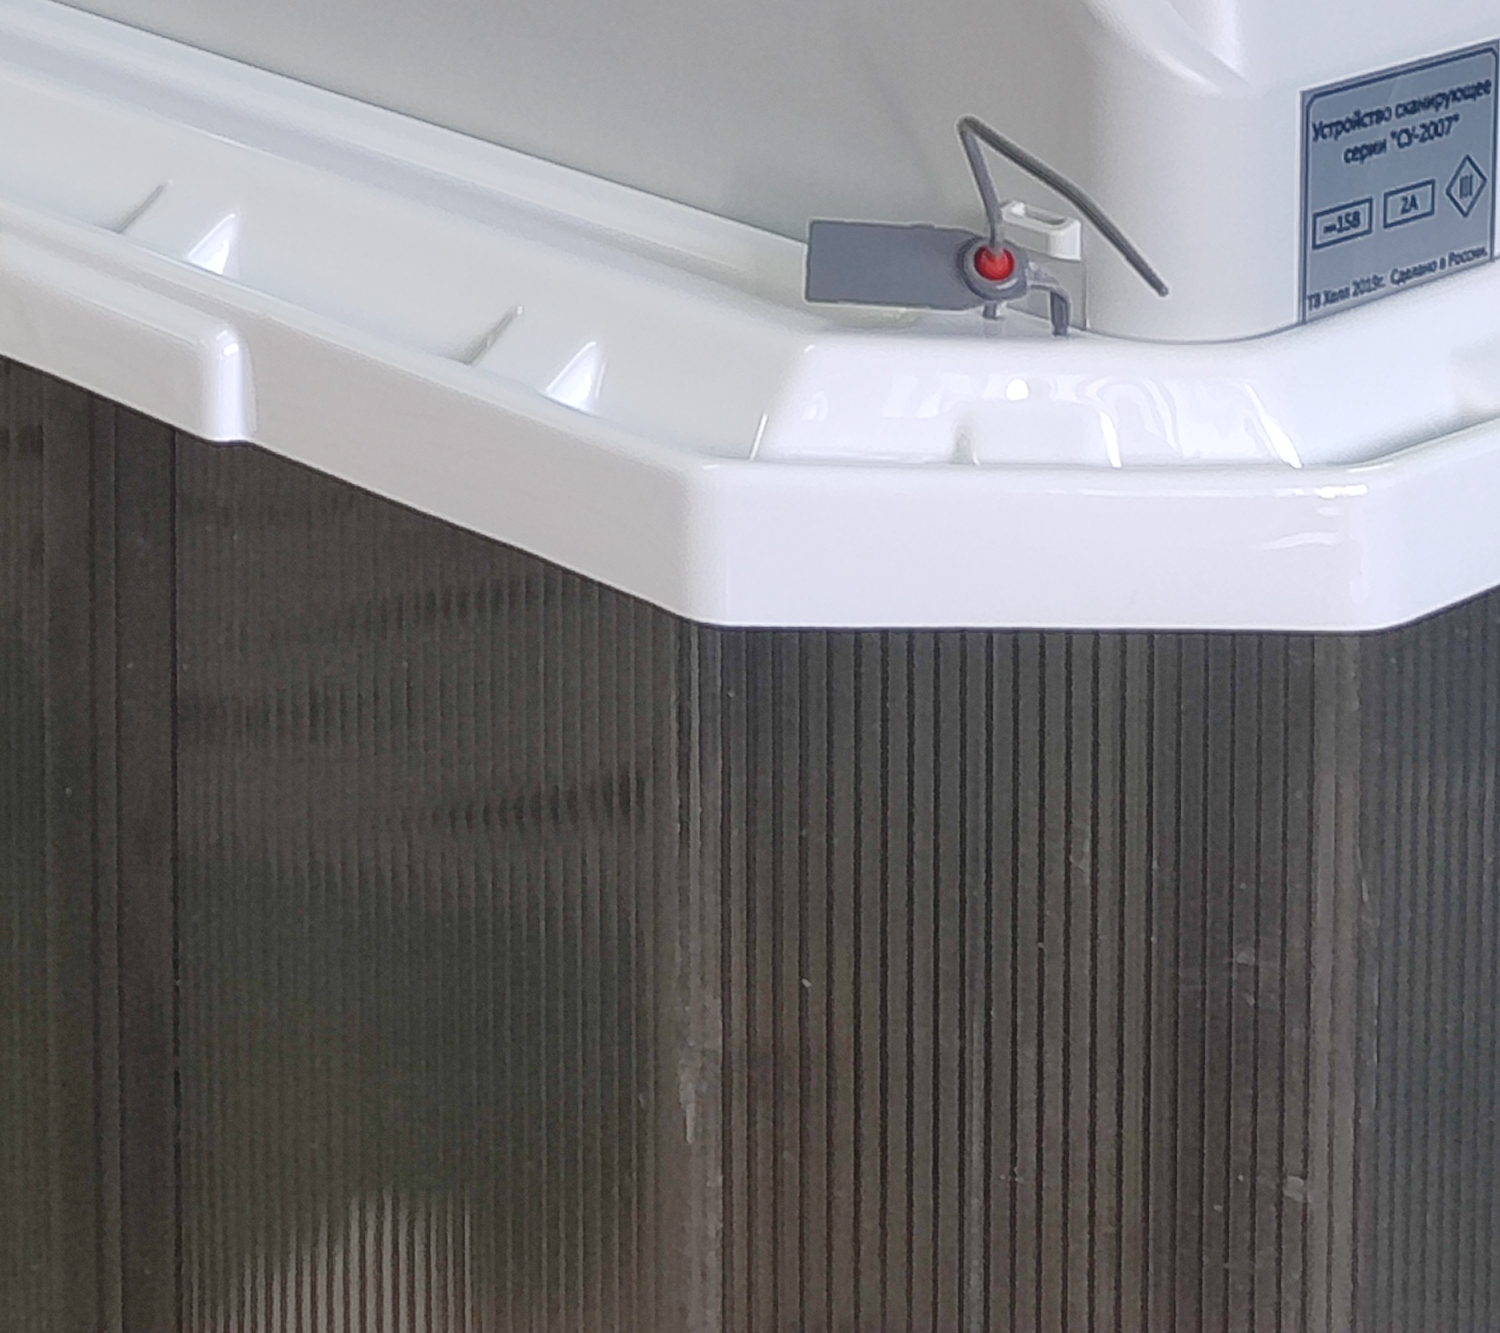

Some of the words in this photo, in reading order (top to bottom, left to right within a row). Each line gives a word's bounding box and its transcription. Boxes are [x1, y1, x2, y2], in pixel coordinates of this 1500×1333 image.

[1312, 106, 1391, 142] Устройство
[1395, 79, 1492, 118] сканирующее
[1343, 139, 1387, 164] серии
[1390, 113, 1460, 148] "СУ-2007"
[1390, 260, 1437, 284] Сделано
[1439, 256, 1446, 270] в
